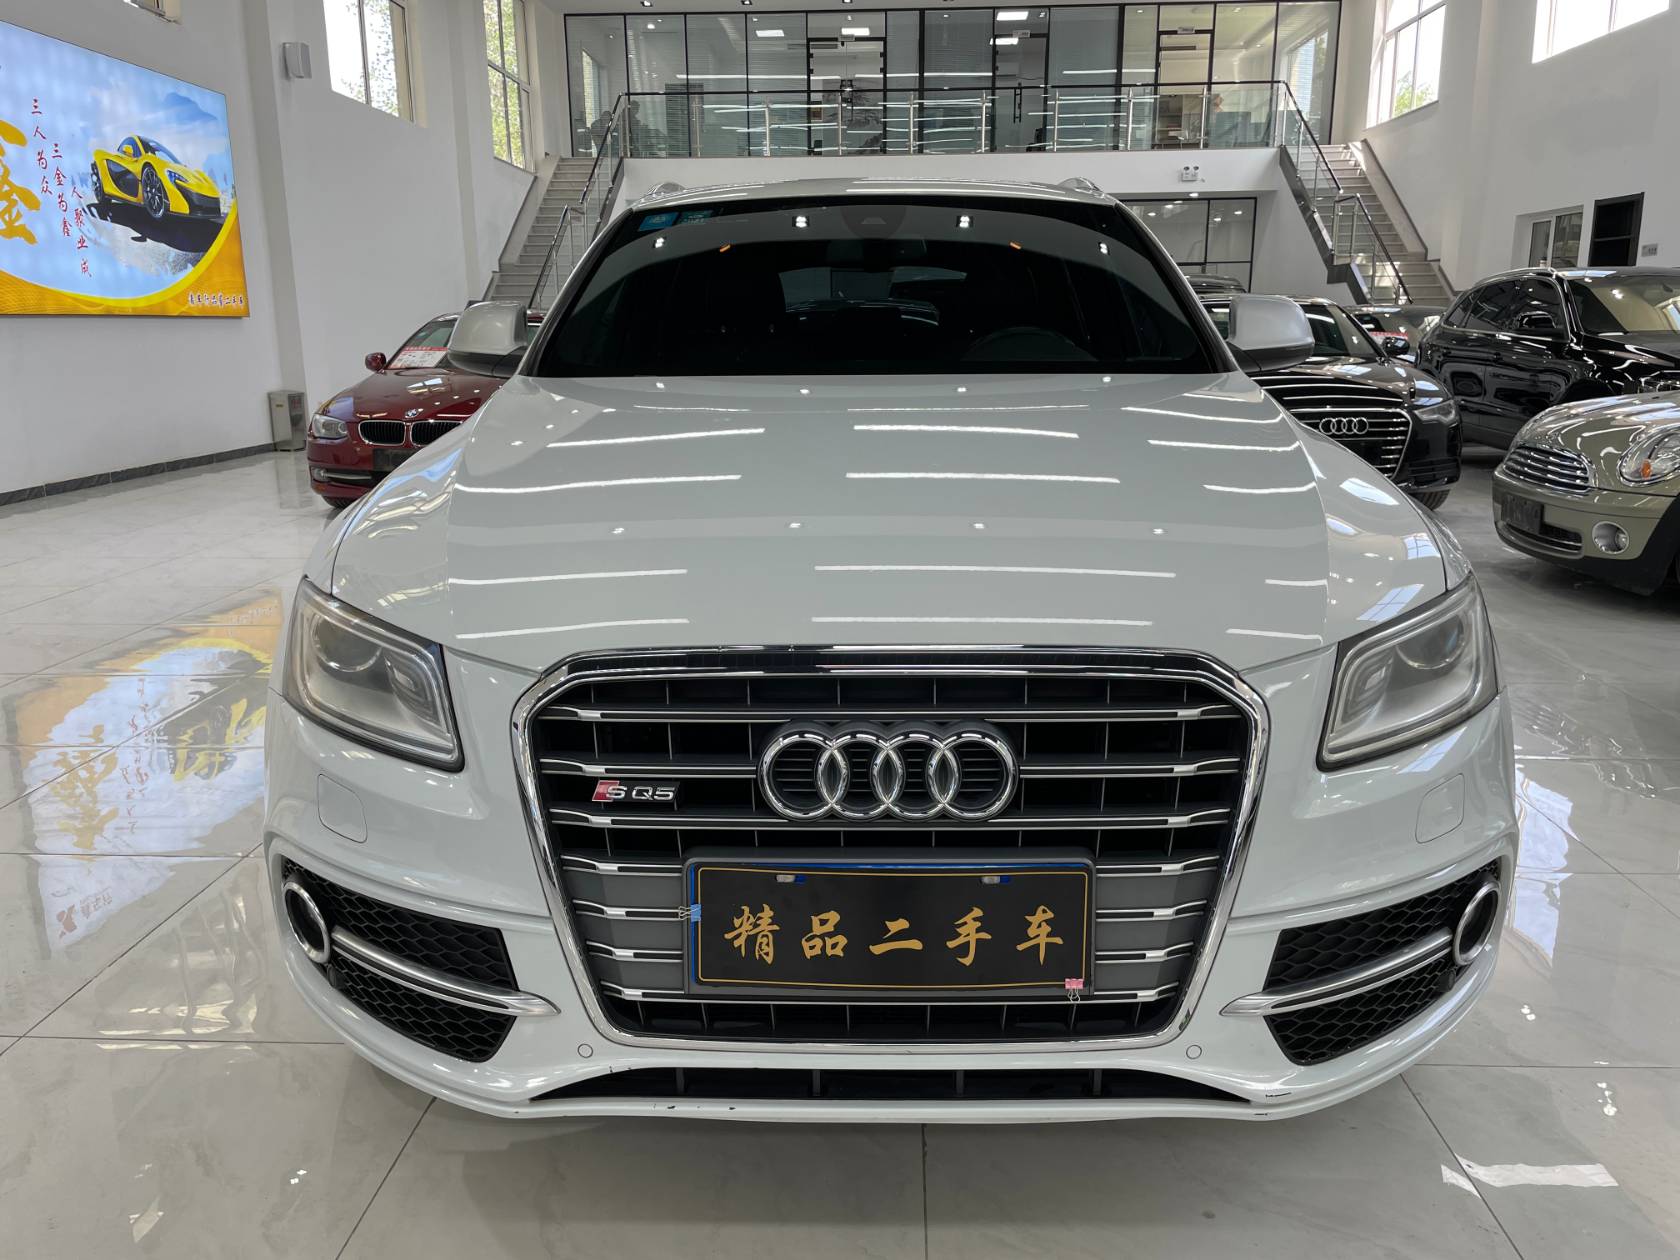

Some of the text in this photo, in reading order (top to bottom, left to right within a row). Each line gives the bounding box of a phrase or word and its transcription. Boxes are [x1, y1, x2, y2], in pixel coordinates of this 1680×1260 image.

[605, 785, 676, 800] SQ5
[723, 903, 1064, 967] 精品二手车
